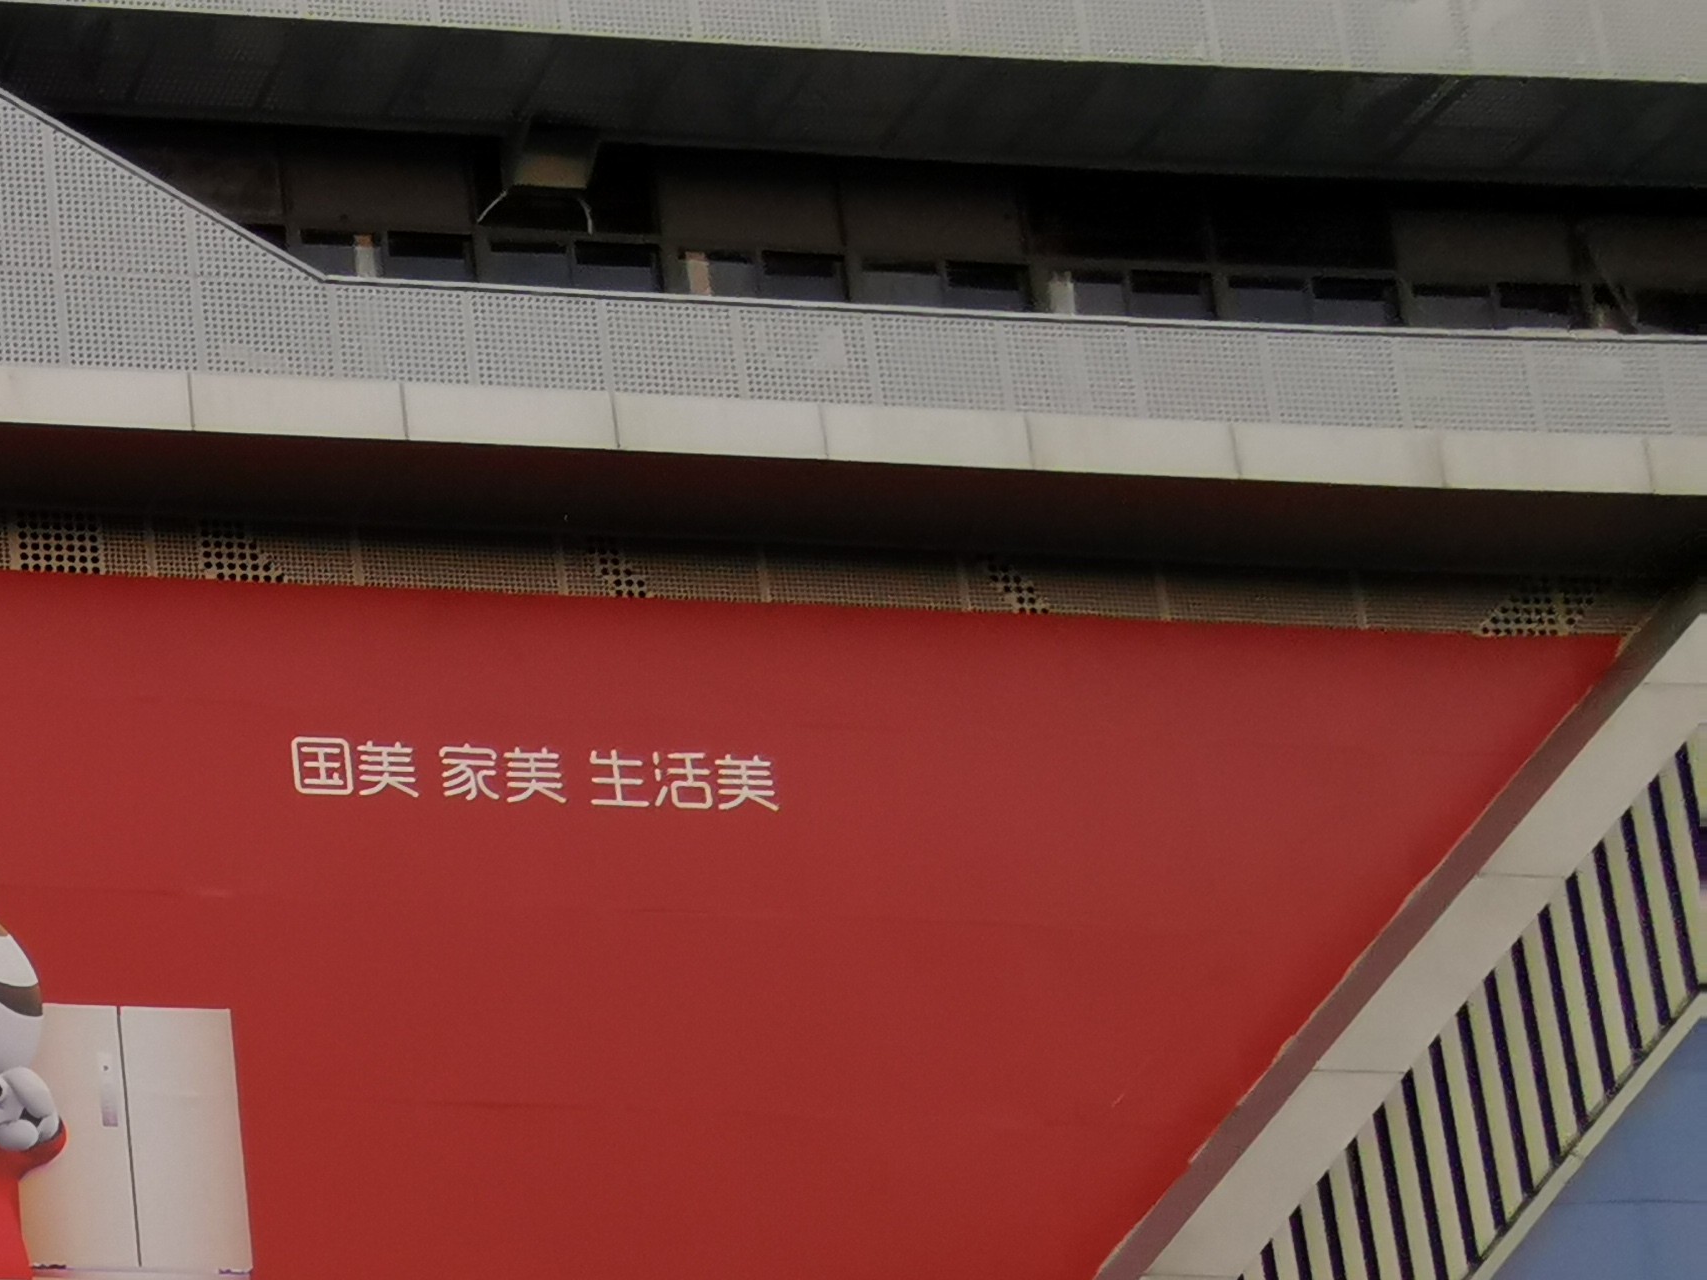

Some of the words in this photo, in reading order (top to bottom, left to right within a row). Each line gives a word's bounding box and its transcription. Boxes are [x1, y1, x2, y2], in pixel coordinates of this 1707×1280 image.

[290, 736, 419, 799] 国美
[438, 742, 568, 804] 家美
[589, 748, 780, 811] 生活美
